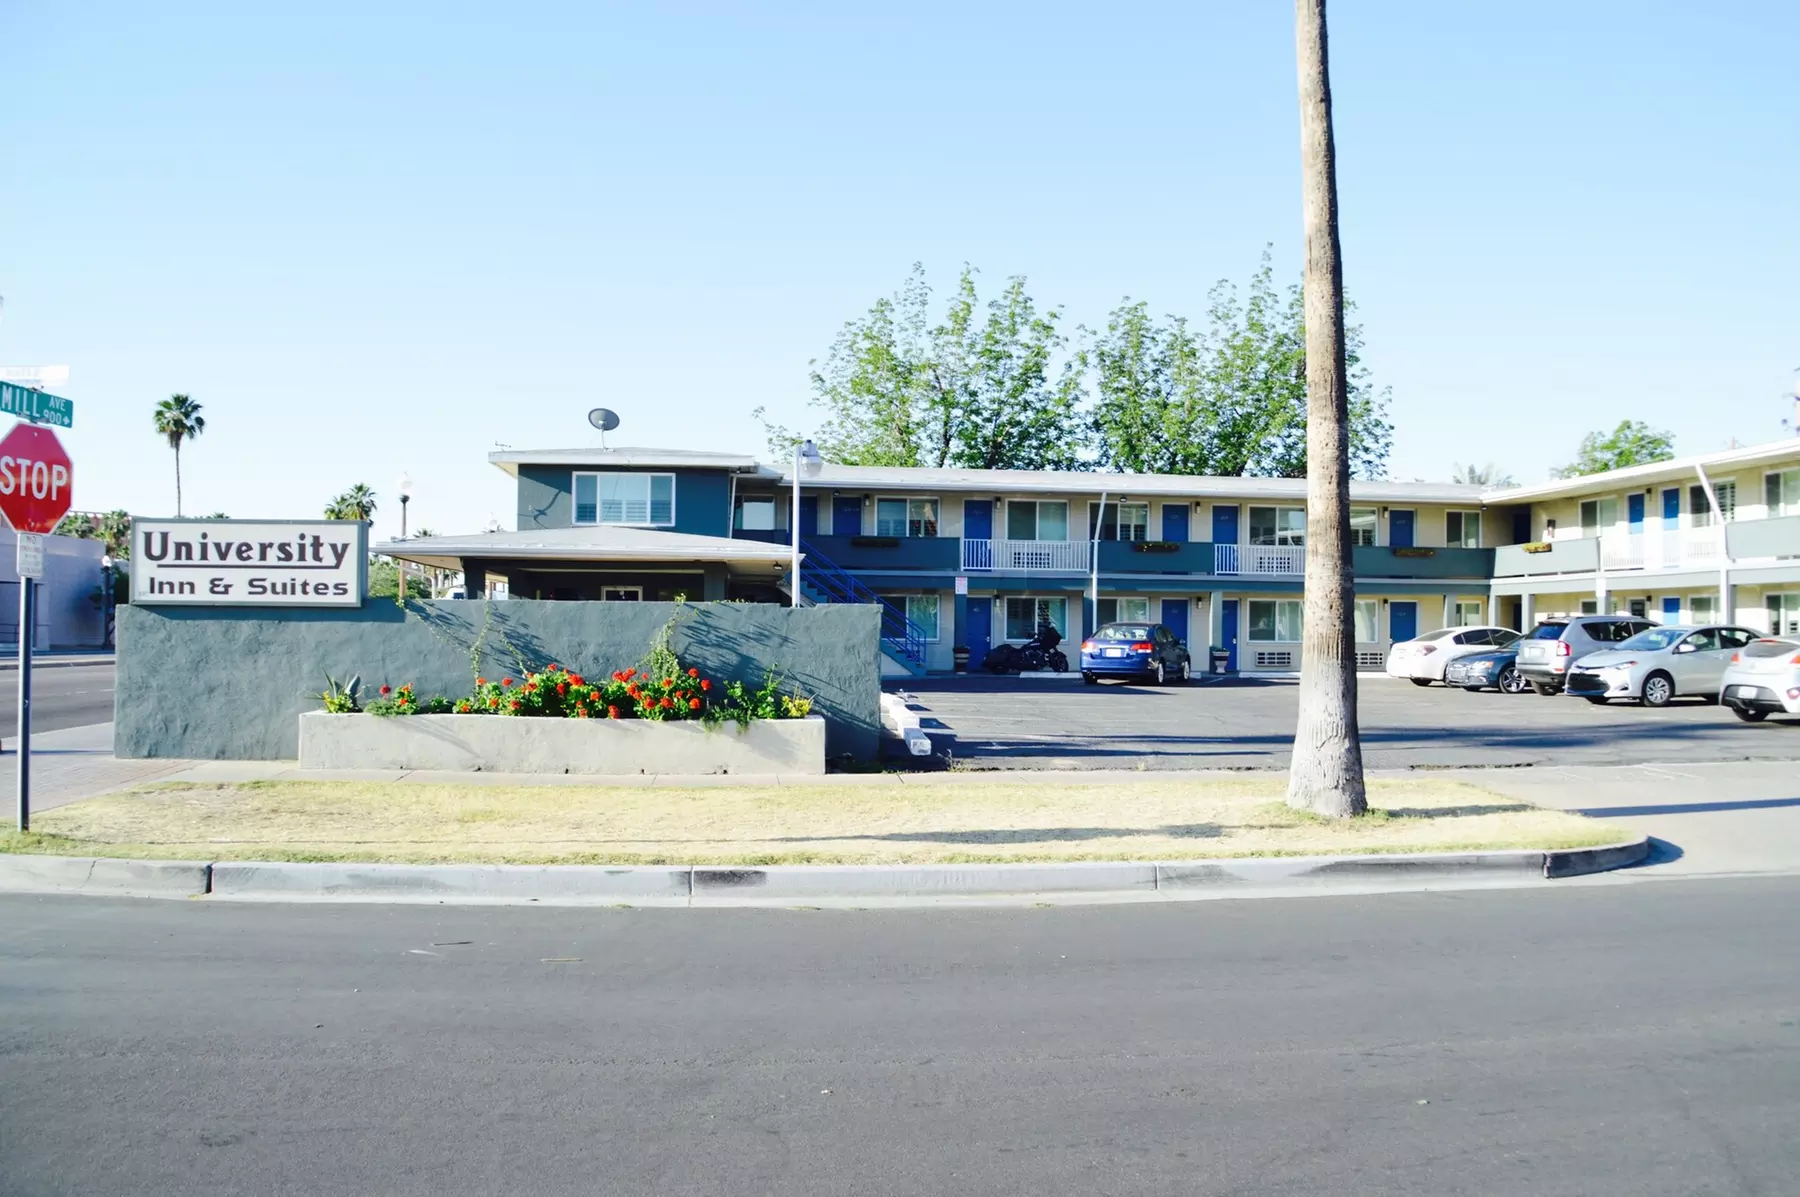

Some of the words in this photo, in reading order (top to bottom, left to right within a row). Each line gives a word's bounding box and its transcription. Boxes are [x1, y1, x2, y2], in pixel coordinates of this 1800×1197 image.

[2, 384, 40, 417] MILL
[49, 396, 66, 412] AVE
[43, 409, 62, 425] 900
[0, 455, 68, 501] STOP
[143, 532, 351, 569] University
[149, 577, 195, 595] Inn
[209, 577, 234, 595] &
[248, 577, 349, 596] Suites
